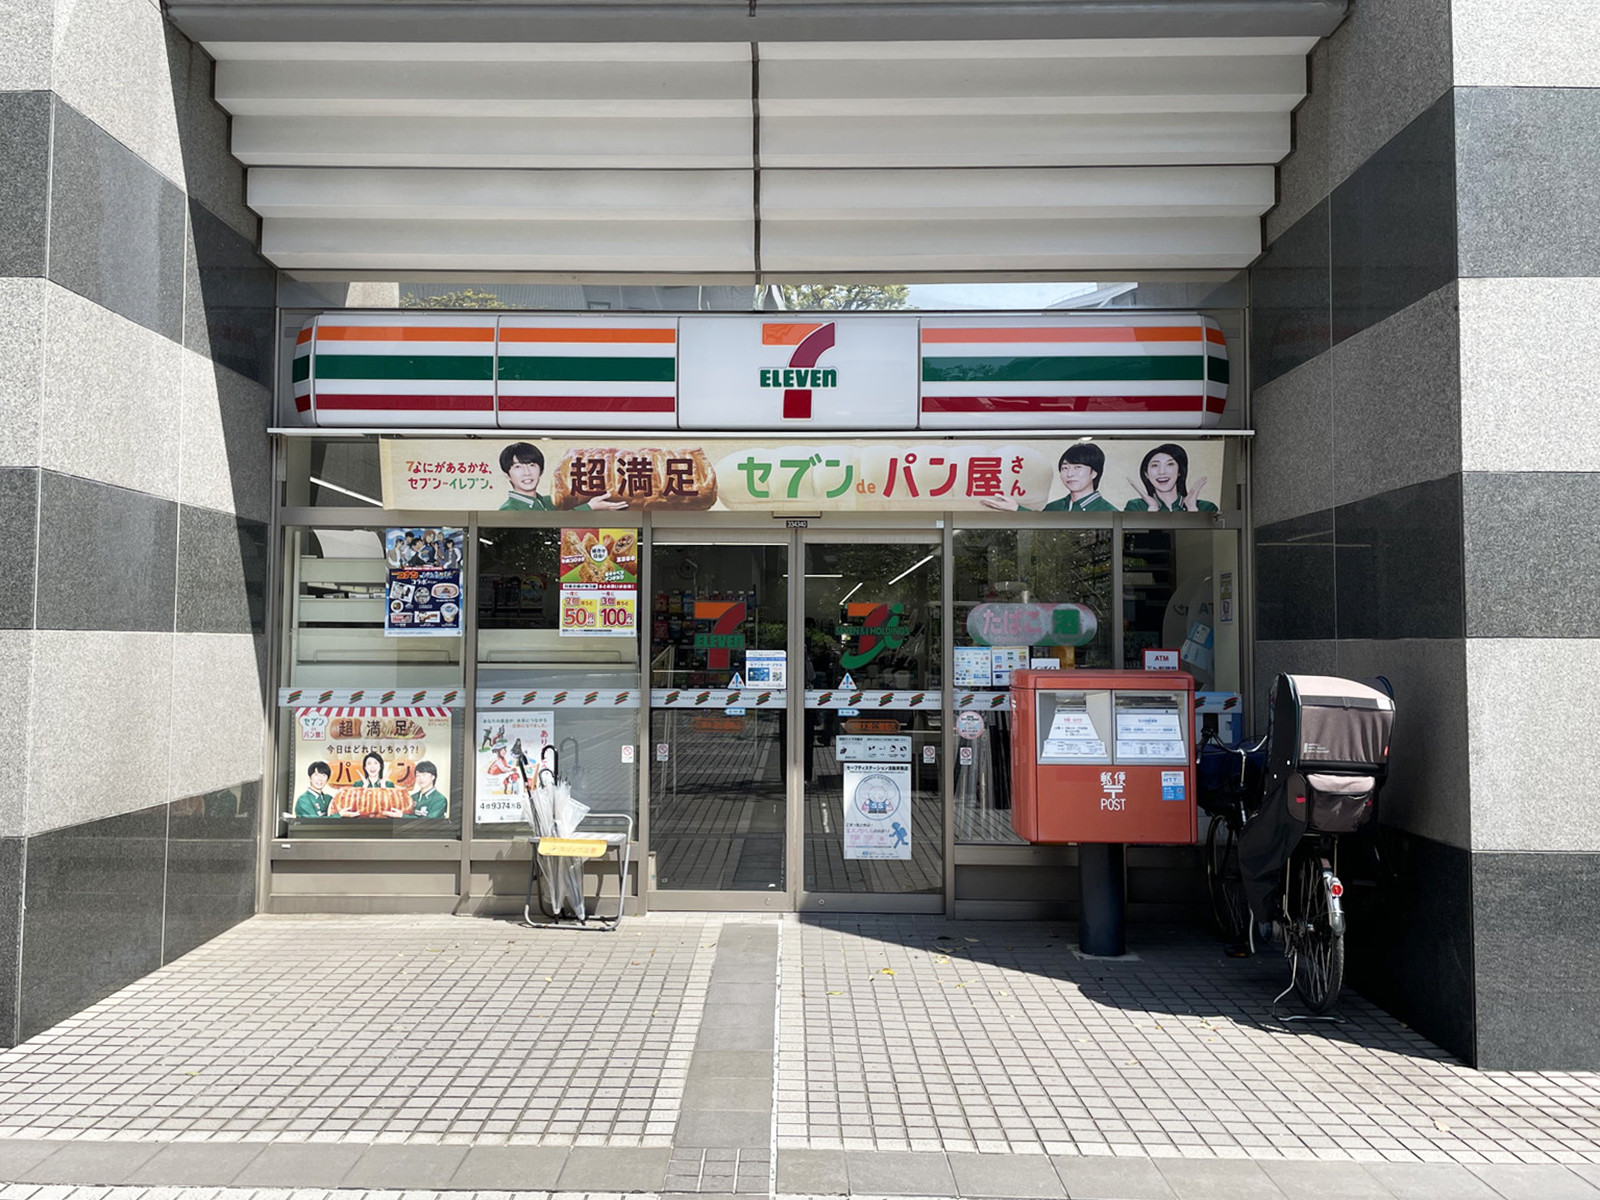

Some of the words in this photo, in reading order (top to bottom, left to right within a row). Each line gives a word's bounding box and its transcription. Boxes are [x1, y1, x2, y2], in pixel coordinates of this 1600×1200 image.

[762, 322, 836, 419] 7
[570, 456, 699, 498] 超満足
[982, 609, 1042, 635] たばこ
[303, 717, 325, 727] セブン
[338, 720, 408, 737] 超満足
[1100, 771, 1126, 786] 郵便
[1100, 798, 1126, 811] POST
